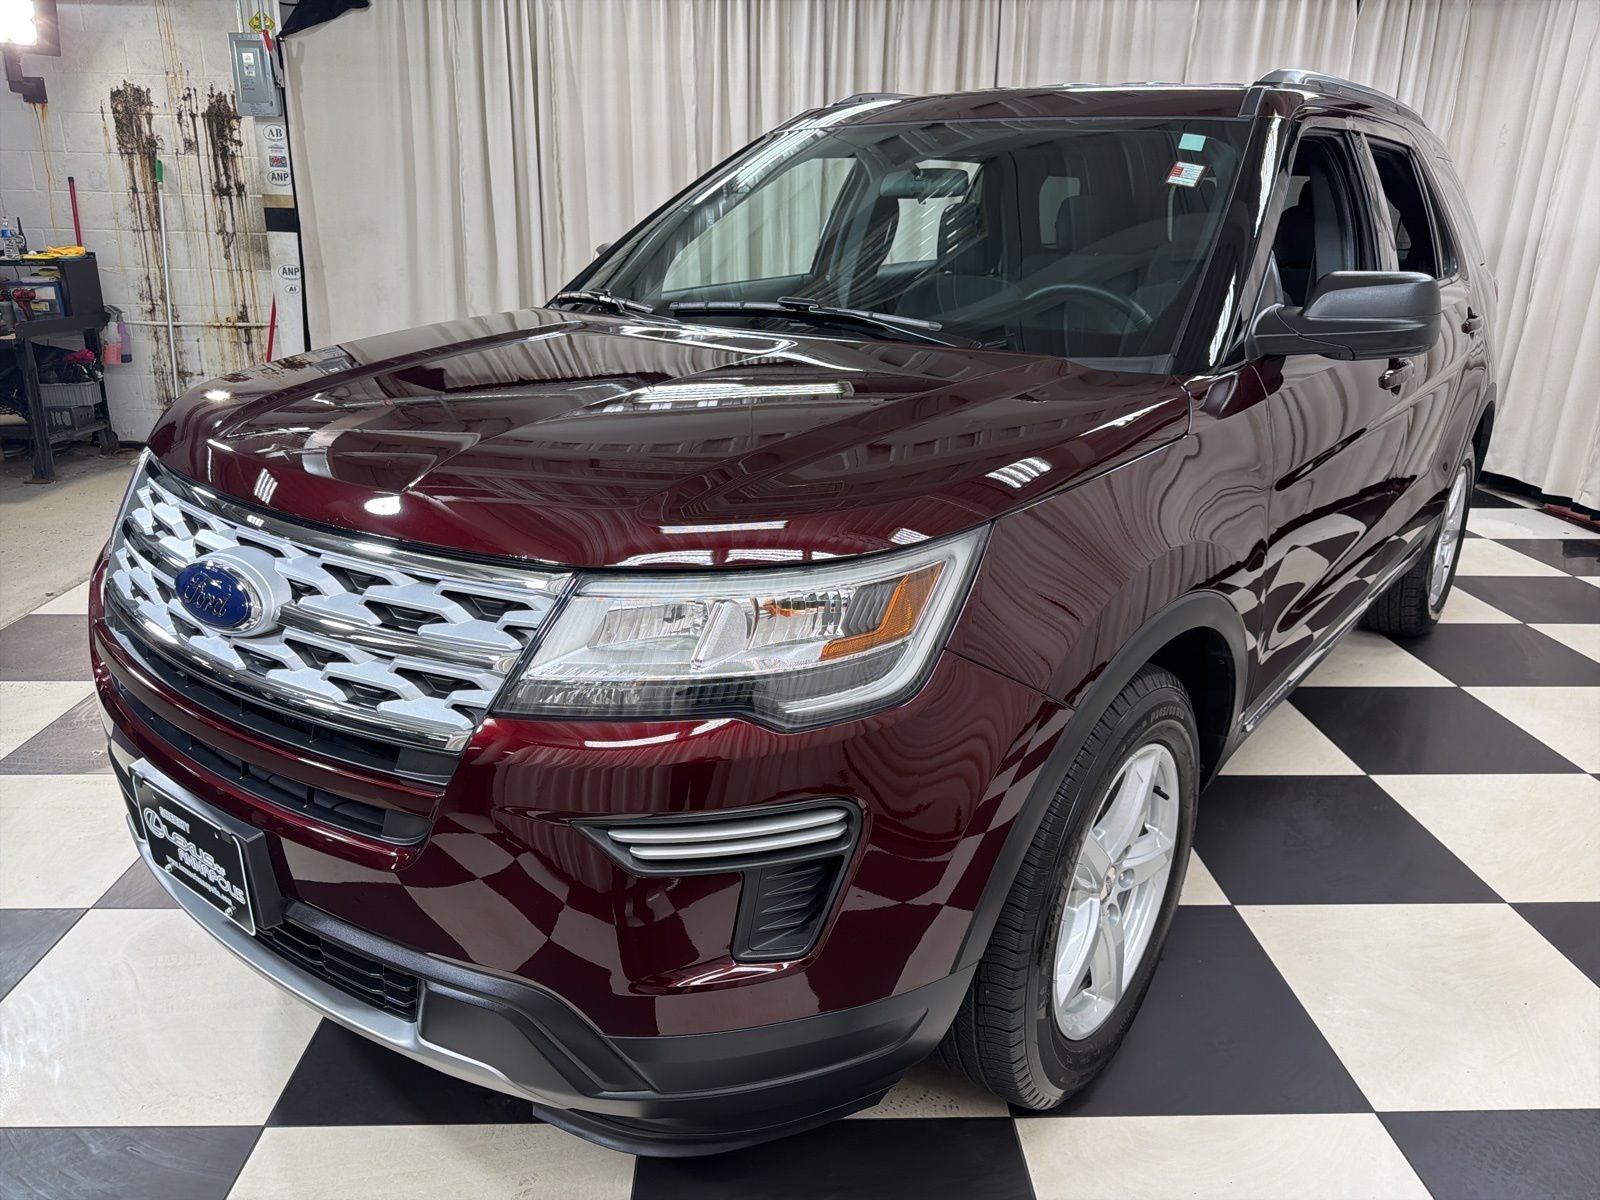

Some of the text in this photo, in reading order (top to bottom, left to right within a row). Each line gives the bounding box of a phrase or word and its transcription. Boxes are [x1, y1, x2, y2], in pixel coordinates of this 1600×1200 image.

[267, 128, 283, 138] AB
[271, 172, 289, 182] ANP
[282, 267, 300, 276] ANP
[184, 571, 232, 618] Ford
[164, 828, 215, 870] LEXUS
